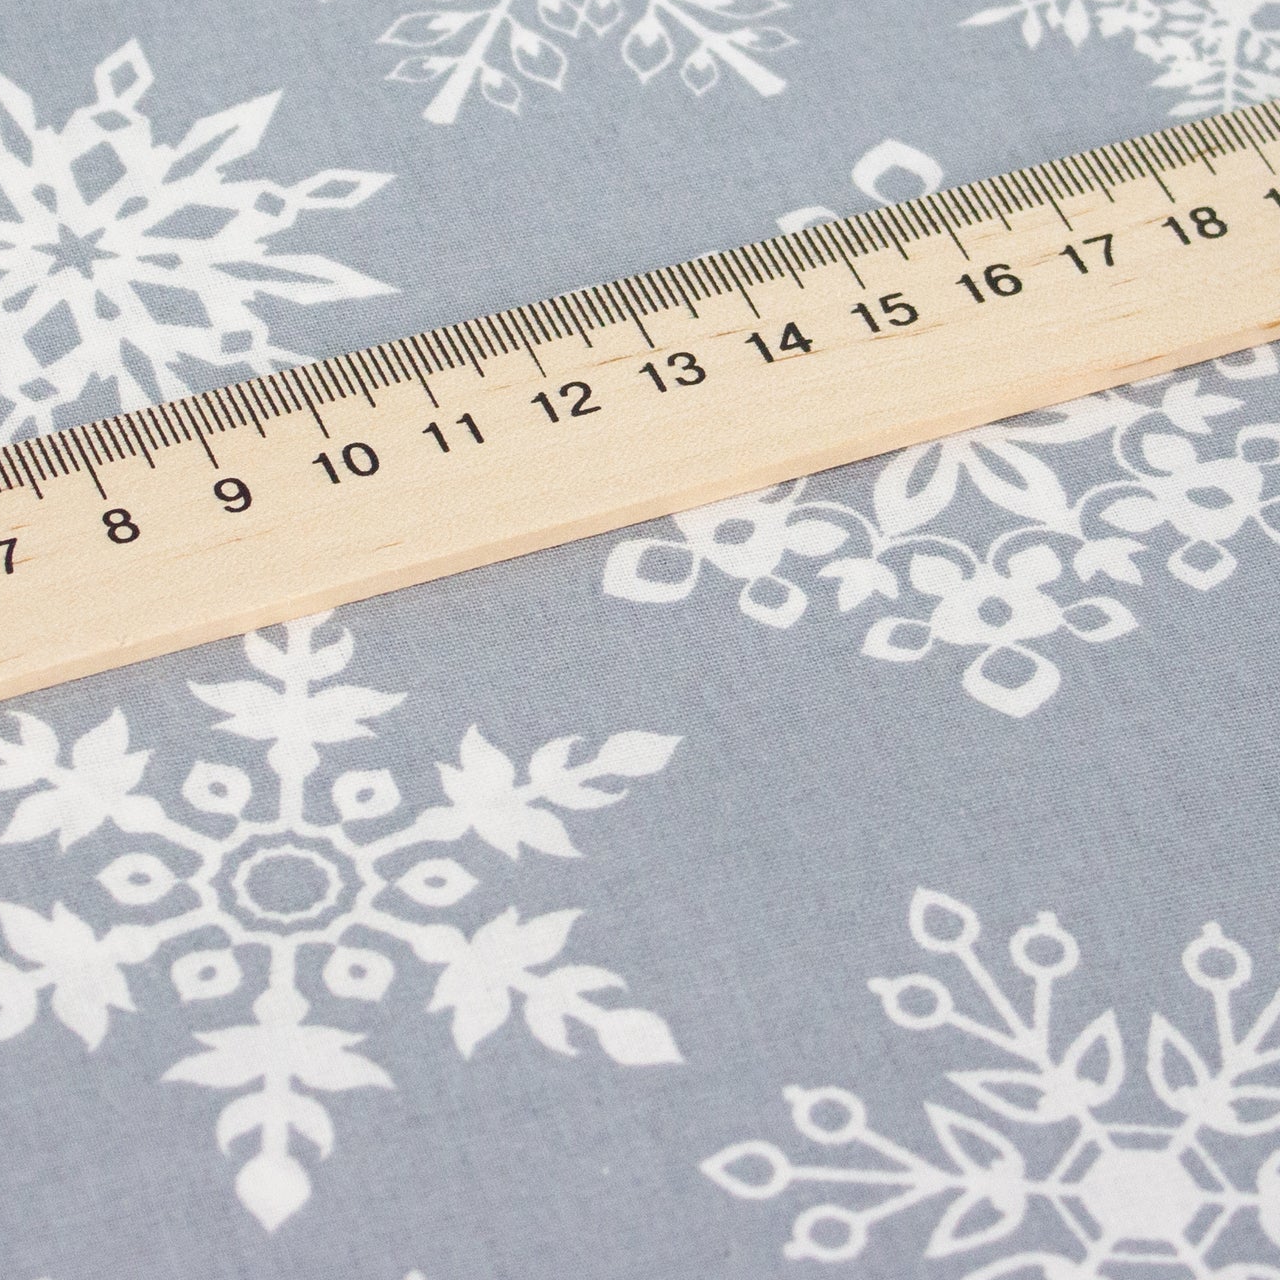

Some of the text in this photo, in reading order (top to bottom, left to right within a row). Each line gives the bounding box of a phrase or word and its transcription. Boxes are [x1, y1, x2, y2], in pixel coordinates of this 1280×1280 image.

[101, 507, 141, 545] 8
[213, 477, 253, 514] 9
[311, 441, 380, 485] 10
[421, 412, 485, 453] 11
[530, 381, 602, 424] 12
[638, 351, 707, 393] 13
[744, 321, 814, 364] 14
[850, 291, 920, 334] 15
[955, 263, 1023, 304] 16
[1058, 233, 1115, 275] 17
[1161, 206, 1229, 246] 18
